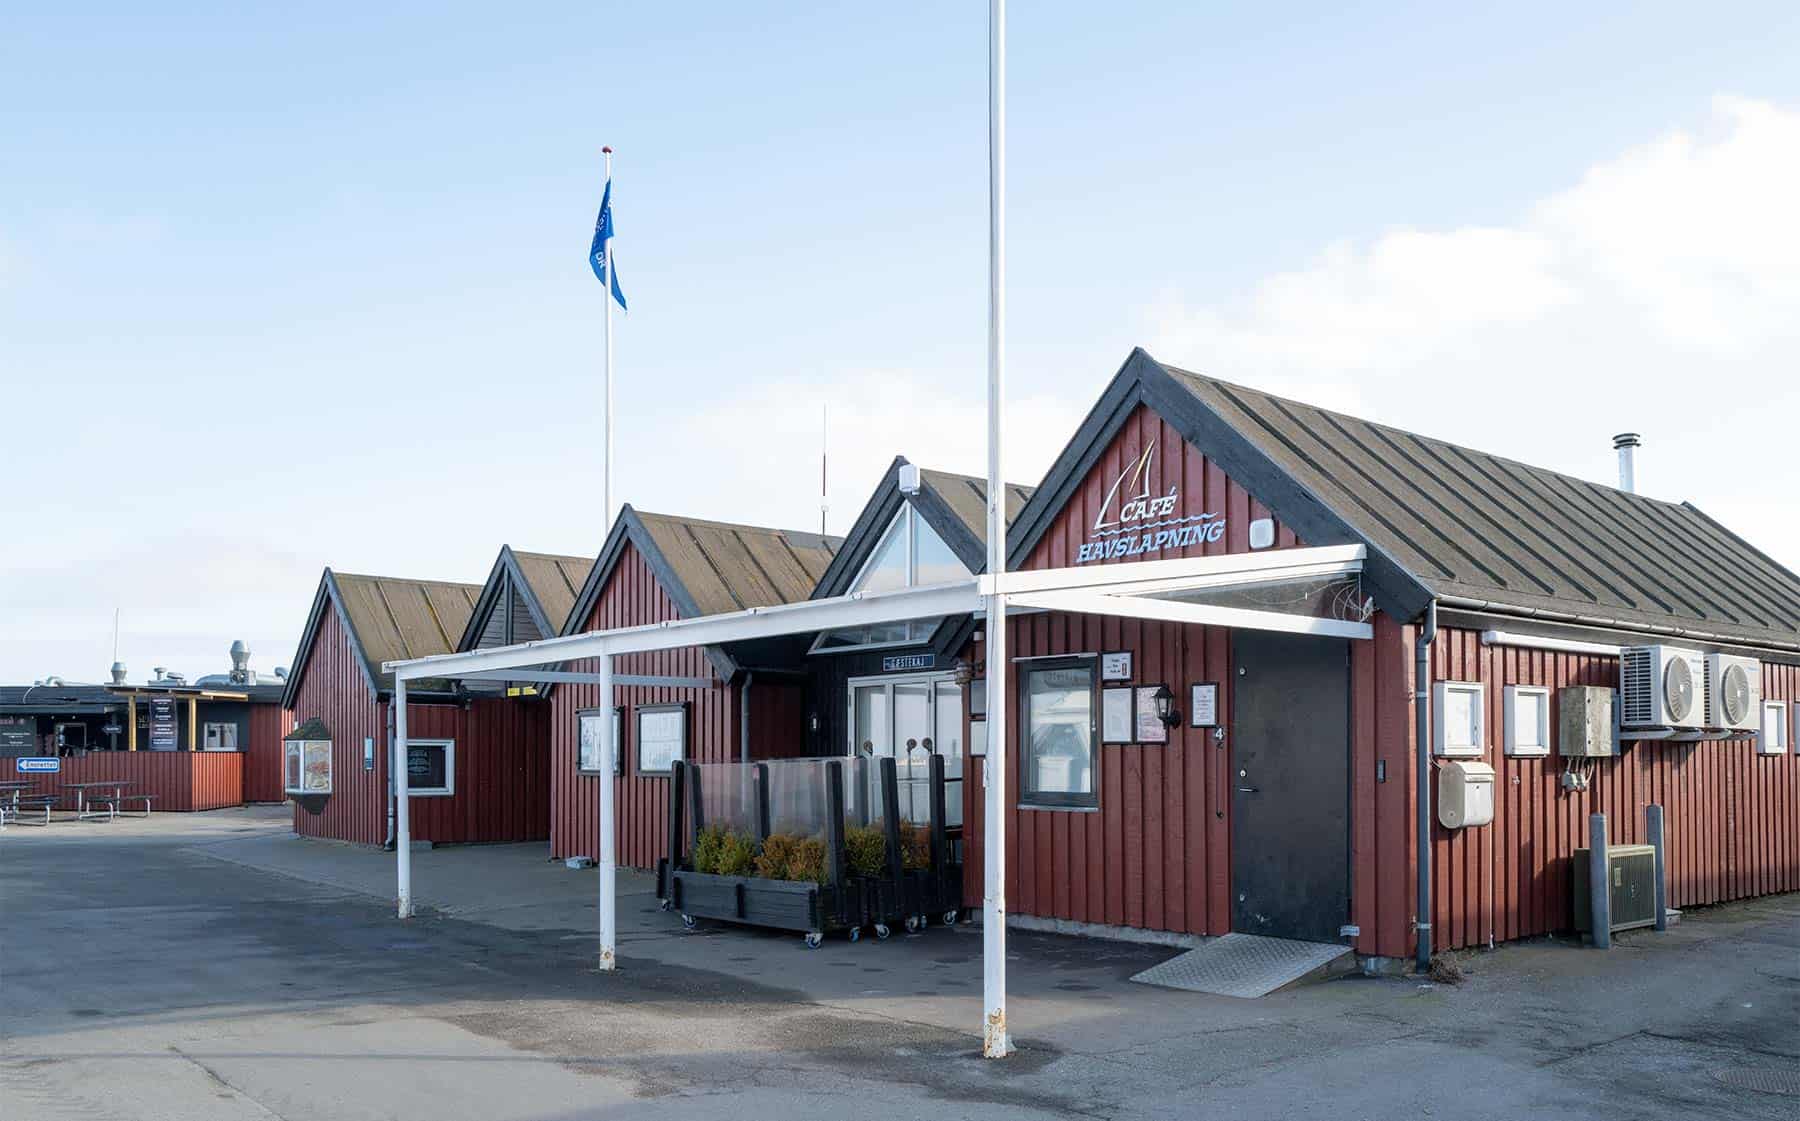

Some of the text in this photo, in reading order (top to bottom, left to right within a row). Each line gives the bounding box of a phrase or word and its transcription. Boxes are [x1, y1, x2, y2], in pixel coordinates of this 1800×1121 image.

[1119, 487, 1178, 522] CAFÉ
[1077, 521, 1226, 562] HAVSLAPNING
[1215, 727, 1224, 740] 4
